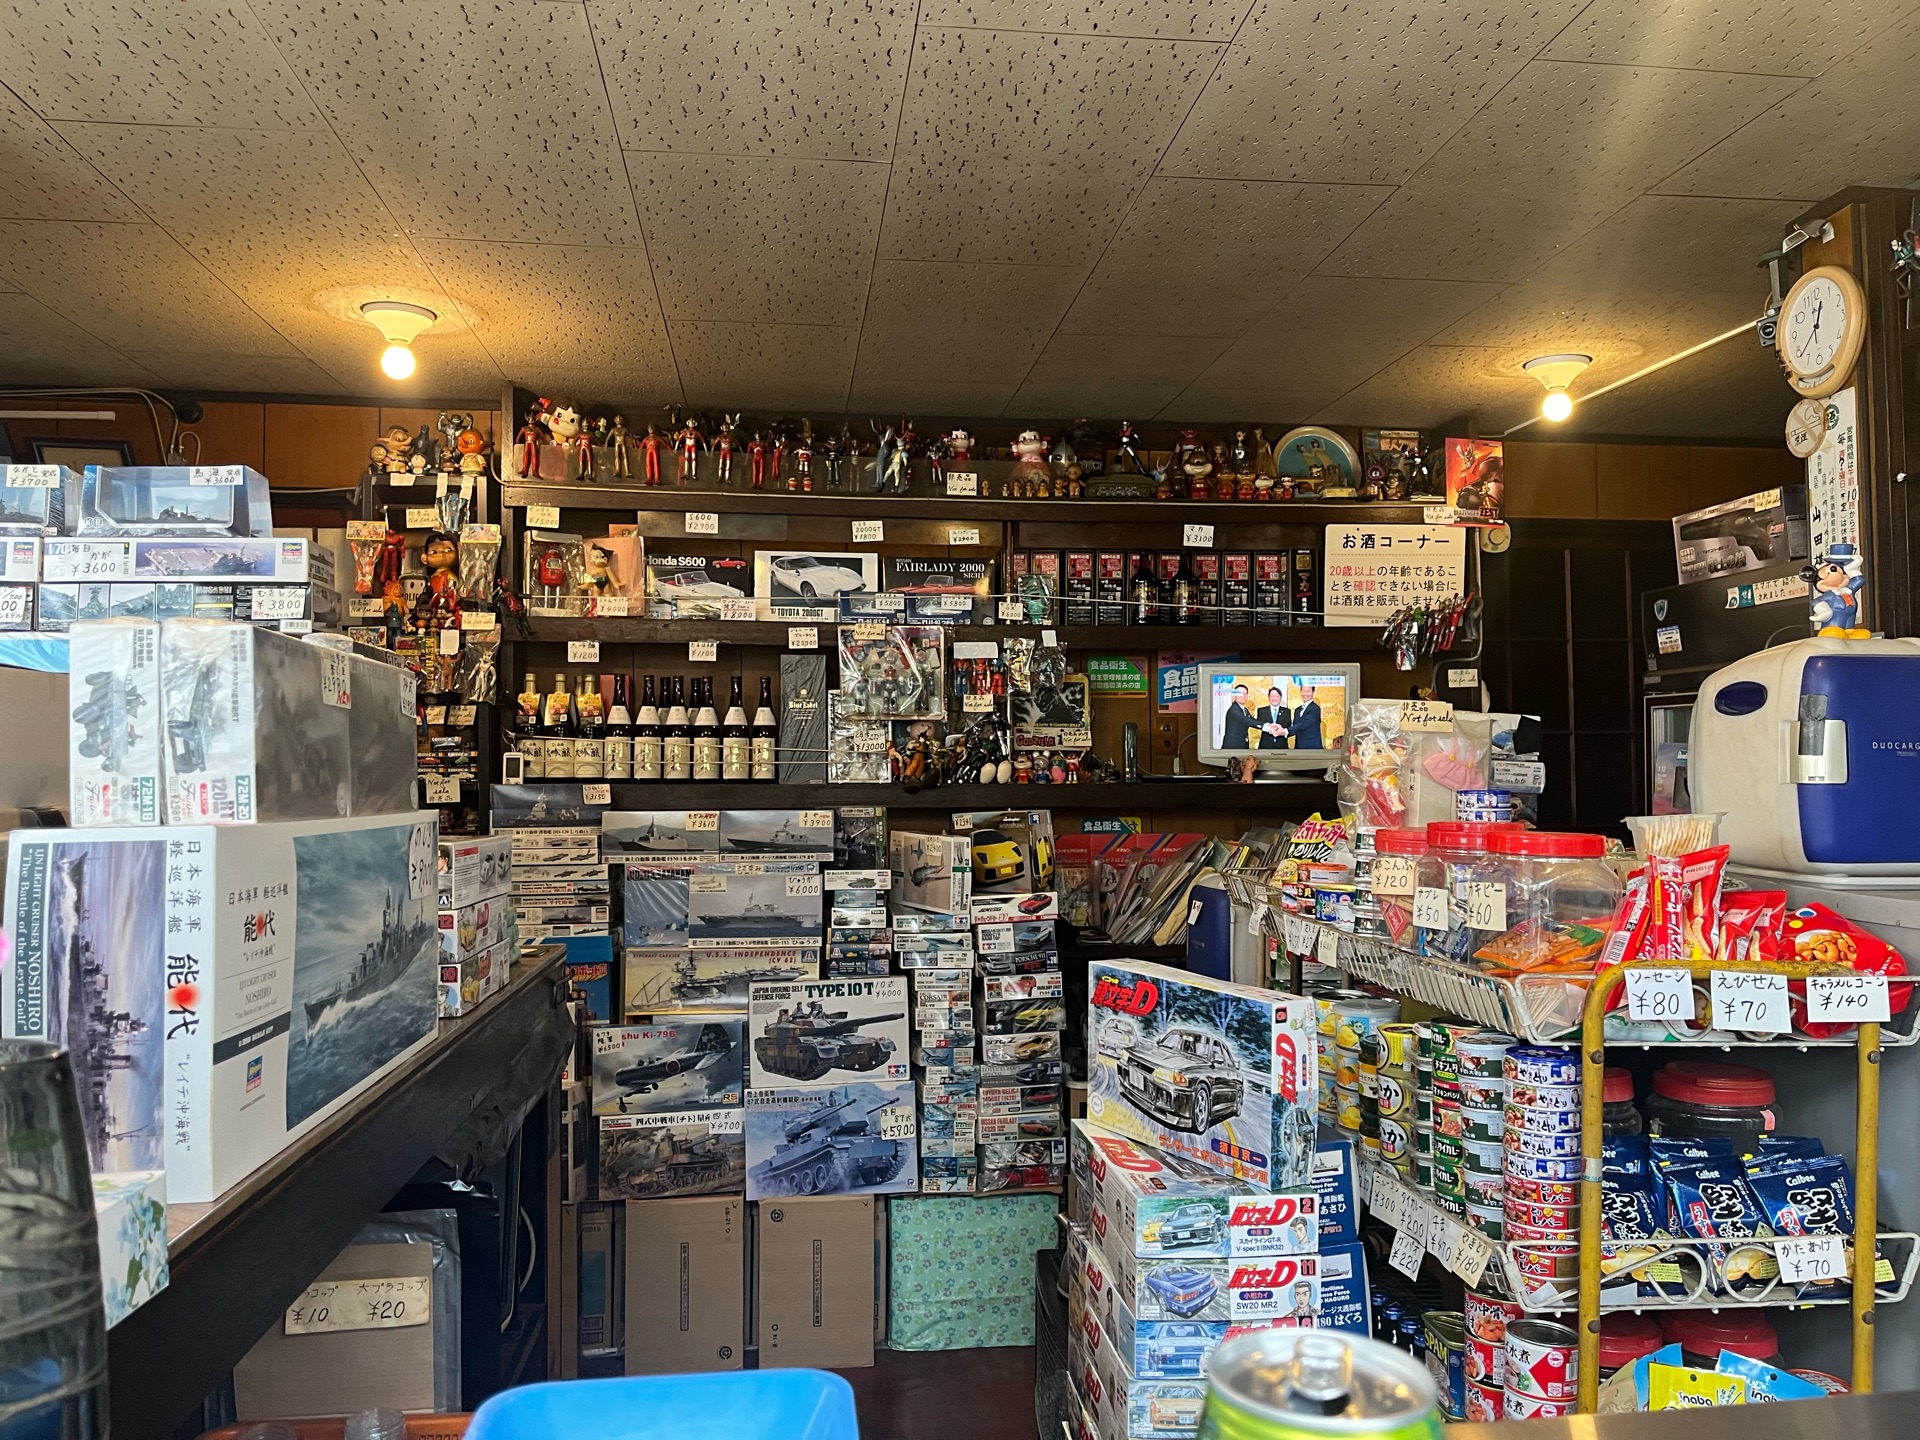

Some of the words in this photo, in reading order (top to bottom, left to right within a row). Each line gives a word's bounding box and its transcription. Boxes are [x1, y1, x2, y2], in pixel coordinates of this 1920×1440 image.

[1794, 311, 1805, 325] 10
[1342, 533, 1450, 549] お酒コーナー
[678, 557, 706, 567] S600
[896, 562, 956, 573] FAIRLADY
[959, 563, 985, 573] 2000
[1330, 565, 1457, 577] 20歳以上の年齢であるこ
[1331, 580, 1457, 592] とを確認できない場合に
[777, 608, 801, 617] TOYOTA
[1090, 661, 1128, 670] 食品衛生
[1401, 713, 1420, 723] Not
[1423, 713, 1436, 726] for
[1438, 714, 1453, 723] sale
[1016, 735, 1056, 747] GODZILLA
[1084, 821, 1121, 831] 食品衛生
[33, 866, 44, 900] LIGHT
[168, 839, 183, 935] 軽巡洋艦
[187, 840, 202, 934] 日本海軍
[1374, 874, 1408, 888] ¥120
[19, 881, 30, 918] Battle
[228, 886, 259, 906] 日本海軍
[439, 915, 454, 928] 12
[1416, 908, 1440, 923] ¥50
[1469, 903, 1492, 925] ¥60
[18, 920, 28, 936] of
[30, 902, 41, 947] CRUISER
[243, 909, 276, 944] 能代
[17, 938, 27, 957] the
[734, 950, 797, 958] INDEPENDENCE
[17, 960, 28, 995] Leyte
[441, 968, 456, 981] 10
[1629, 970, 1690, 984] ソーセージ
[28, 950, 42, 1031] NOSHIRO
[752, 986, 769, 994] JAPAN
[770, 985, 791, 993] GROUND
[804, 983, 845, 998] TYPE
[847, 982, 862, 996] 10
[1716, 974, 1786, 992] えびせん
[1810, 977, 1885, 992] キャラメルコーン
[244, 986, 271, 1004] NOSHIRO
[752, 993, 774, 1001] DEFENSE
[1820, 993, 1869, 1011] ¥140
[1632, 990, 1680, 1016] ¥80
[1723, 1001, 1768, 1023] ¥70
[642, 1030, 676, 1040] Ki-79B
[1683, 1147, 1709, 1158] Calbee
[1695, 1170, 1720, 1179] Calbee
[1786, 1174, 1816, 1186] Calbee
[1302, 1199, 1312, 1213] 2
[1374, 1190, 1396, 1212] ¥300
[1320, 1203, 1347, 1215] あさひ
[1400, 1208, 1424, 1239] ¥200
[1261, 1244, 1284, 1252] (BNR32)
[1781, 1238, 1834, 1257] かたあげ
[1301, 1261, 1314, 1274] 11
[1391, 1247, 1419, 1274] ¥220
[1455, 1247, 1480, 1275] ¥180
[1789, 1259, 1831, 1277] ¥70
[291, 1306, 330, 1325] ¥10
[368, 1300, 406, 1321] ¥20
[1236, 1302, 1259, 1310] SW20
[1261, 1301, 1278, 1309] MR2
[1335, 1311, 1363, 1326] はぐろ
[1424, 1326, 1448, 1365] SPAM
[1678, 1391, 1713, 1406] inaba
